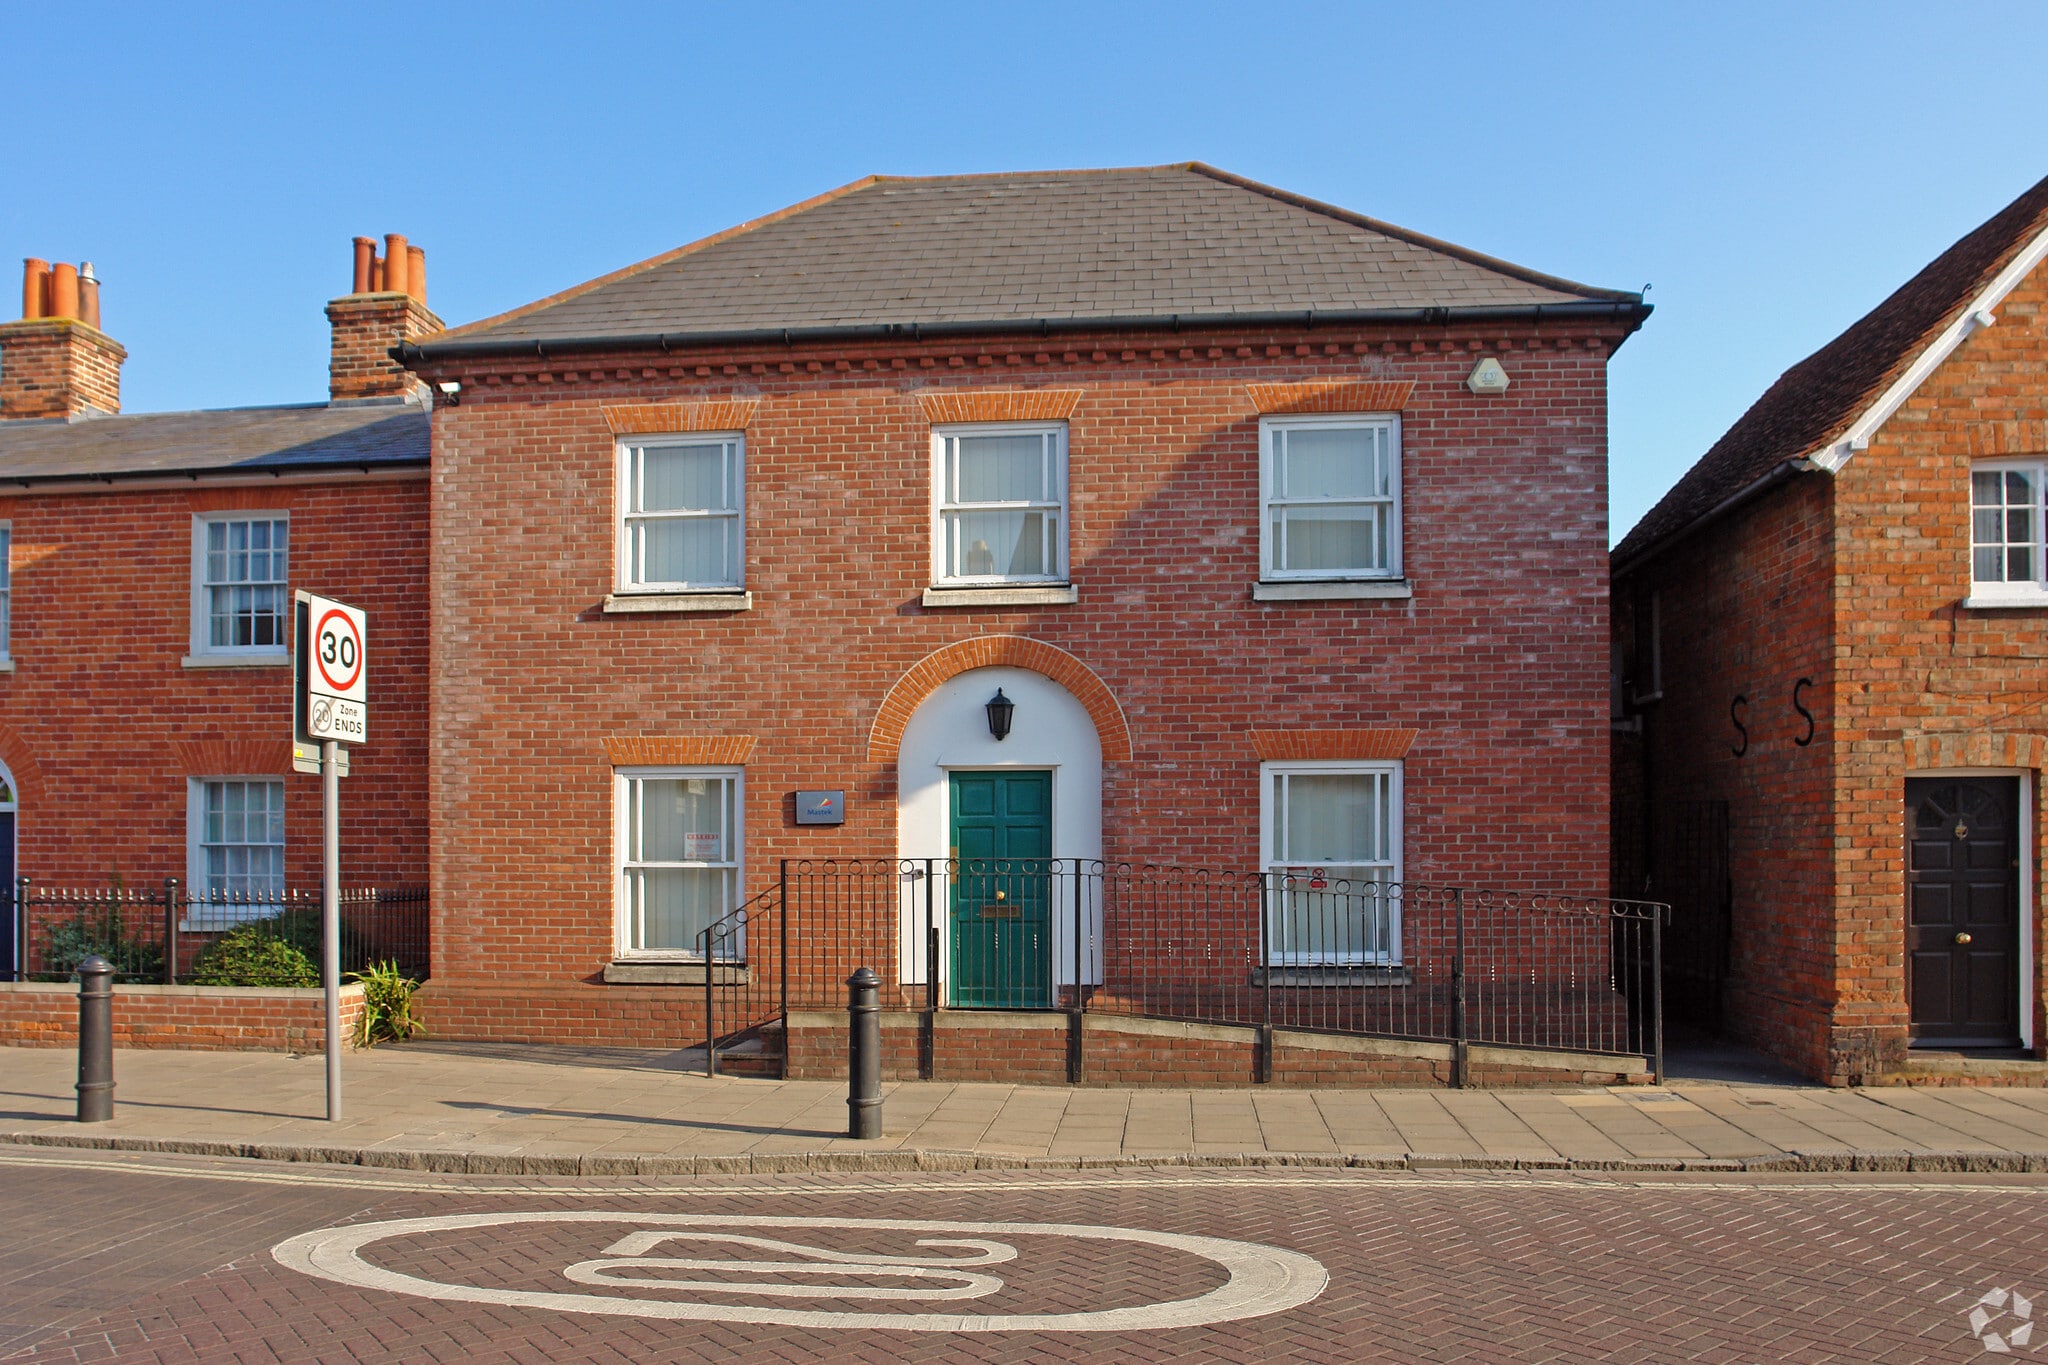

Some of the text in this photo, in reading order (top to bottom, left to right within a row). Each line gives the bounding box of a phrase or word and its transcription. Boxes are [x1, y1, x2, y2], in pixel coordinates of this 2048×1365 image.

[321, 631, 355, 669] 30
[315, 708, 330, 723] 20
[340, 704, 358, 717] Zone
[335, 718, 362, 734] ENDS
